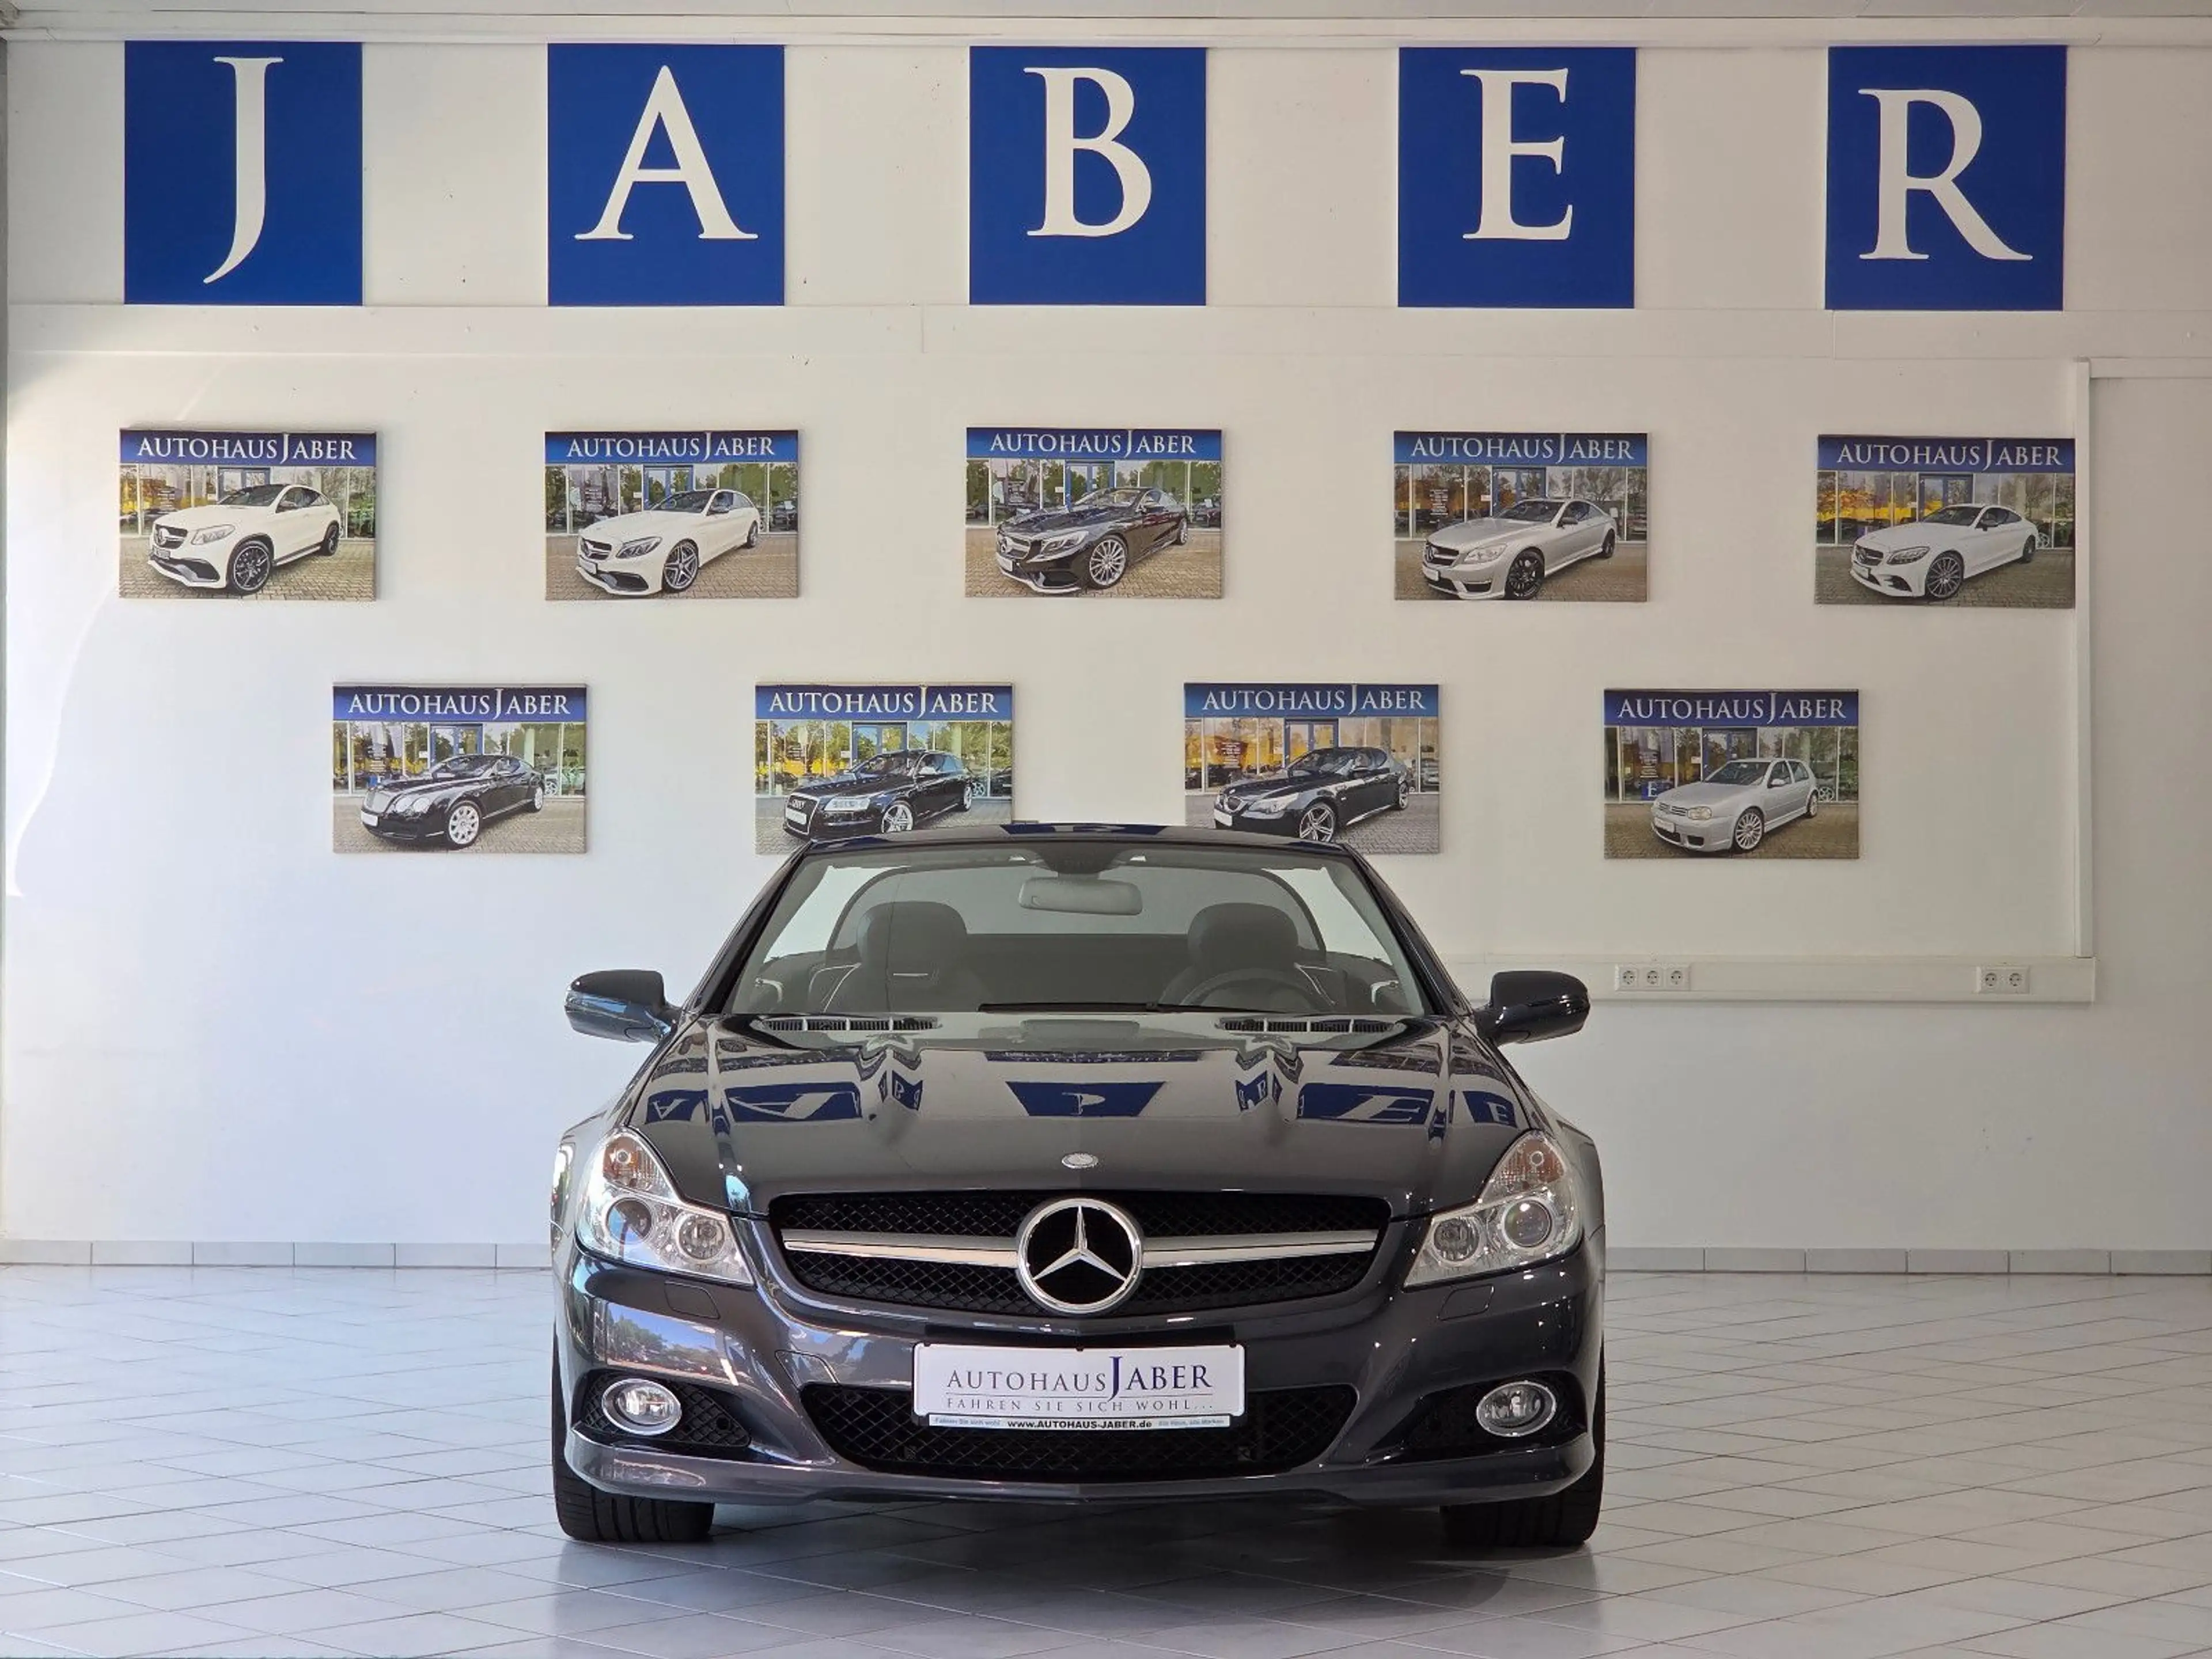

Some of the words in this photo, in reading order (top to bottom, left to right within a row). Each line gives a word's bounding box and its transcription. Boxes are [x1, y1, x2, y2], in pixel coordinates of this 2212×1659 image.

[947, 1398, 1021, 1411] FAHREN
[1035, 1400, 1063, 1411] SIE
[1077, 1400, 1123, 1412] SICH
[1007, 1419, 1152, 1429] www.AUTOHAUS-JABER.de
